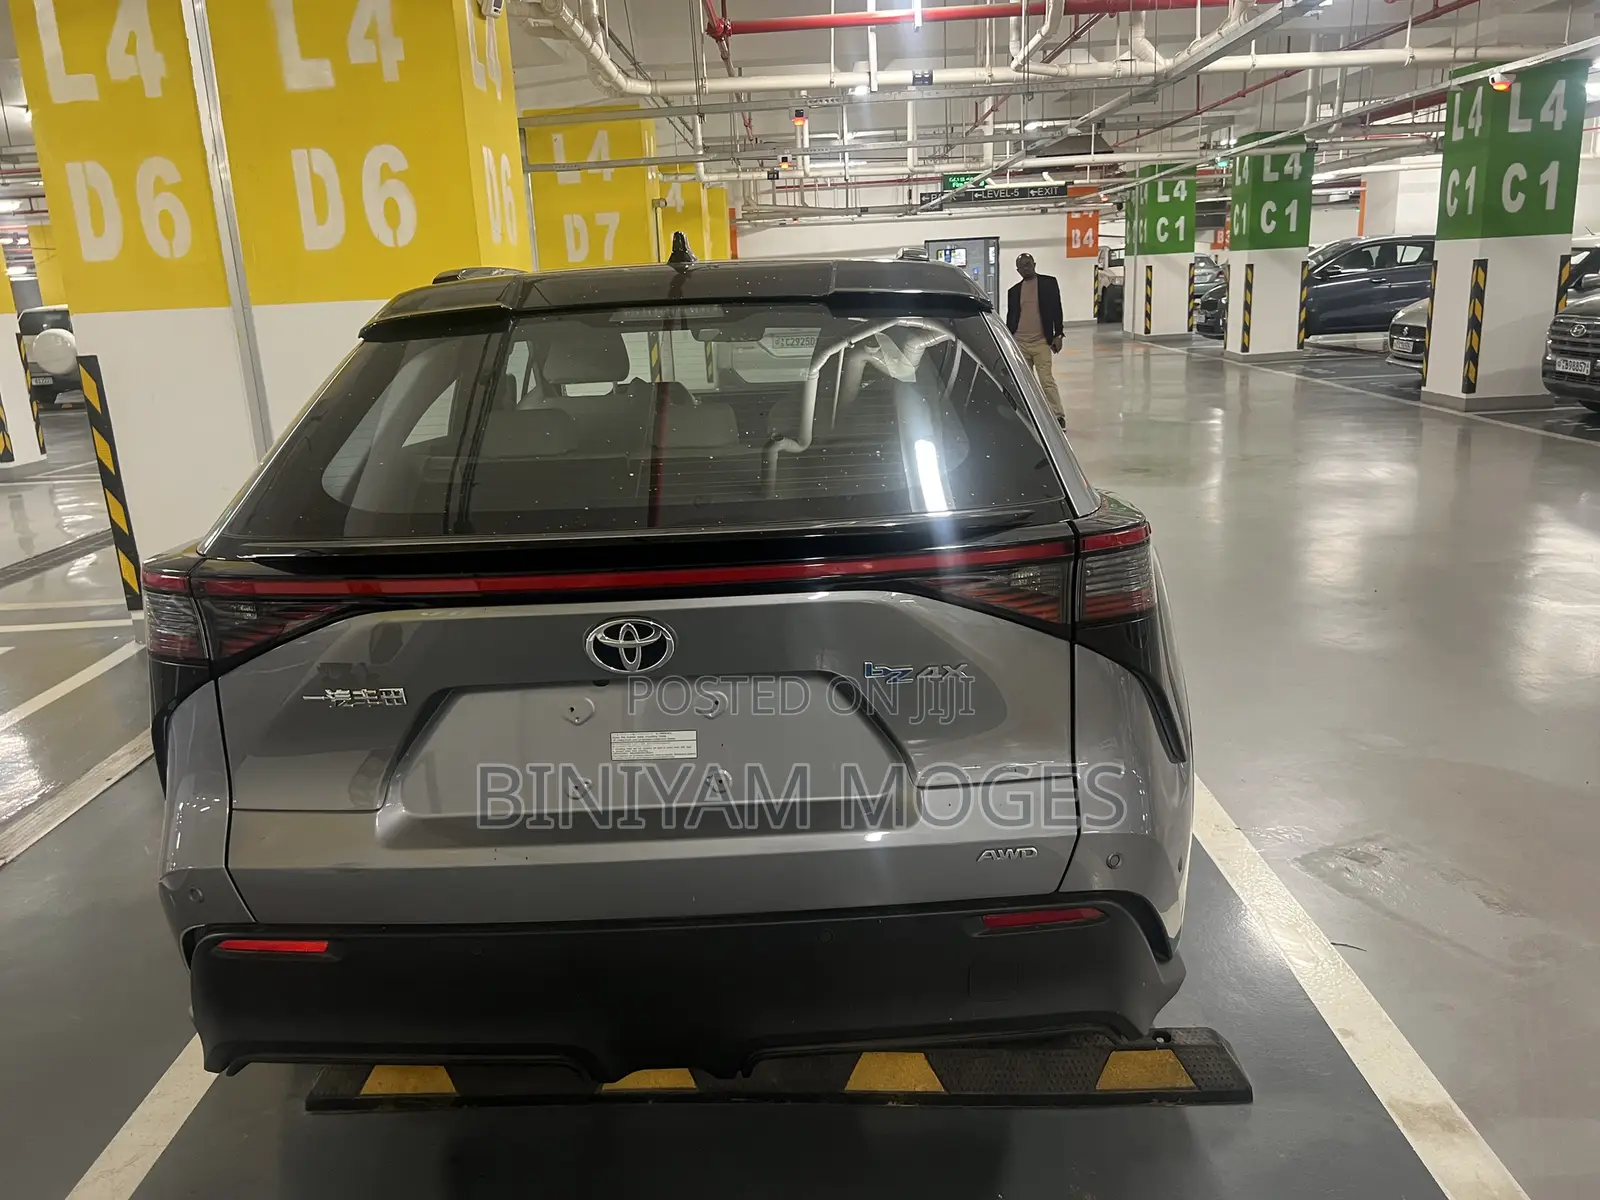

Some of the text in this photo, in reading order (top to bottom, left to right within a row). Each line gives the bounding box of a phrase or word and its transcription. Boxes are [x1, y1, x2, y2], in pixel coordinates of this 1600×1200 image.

[35, 0, 167, 103] L4
[270, 0, 404, 91] L4
[1452, 86, 1483, 141] L4
[1508, 79, 1567, 133] L4
[552, 130, 615, 185] L4
[65, 156, 192, 262] D6
[291, 144, 417, 251] D6
[482, 145, 517, 246] D6
[982, 188, 1020, 199] LEVEL-5
[1037, 186, 1059, 196] EXIT
[1446, 165, 1476, 217] C1
[1502, 160, 1559, 213] C1
[563, 212, 620, 263] D7
[1071, 228, 1094, 248] B4
[1156, 216, 1185, 243] C1
[1233, 202, 1247, 236] C1
[1260, 199, 1298, 234] C1
[977, 846, 1038, 863] AWD
